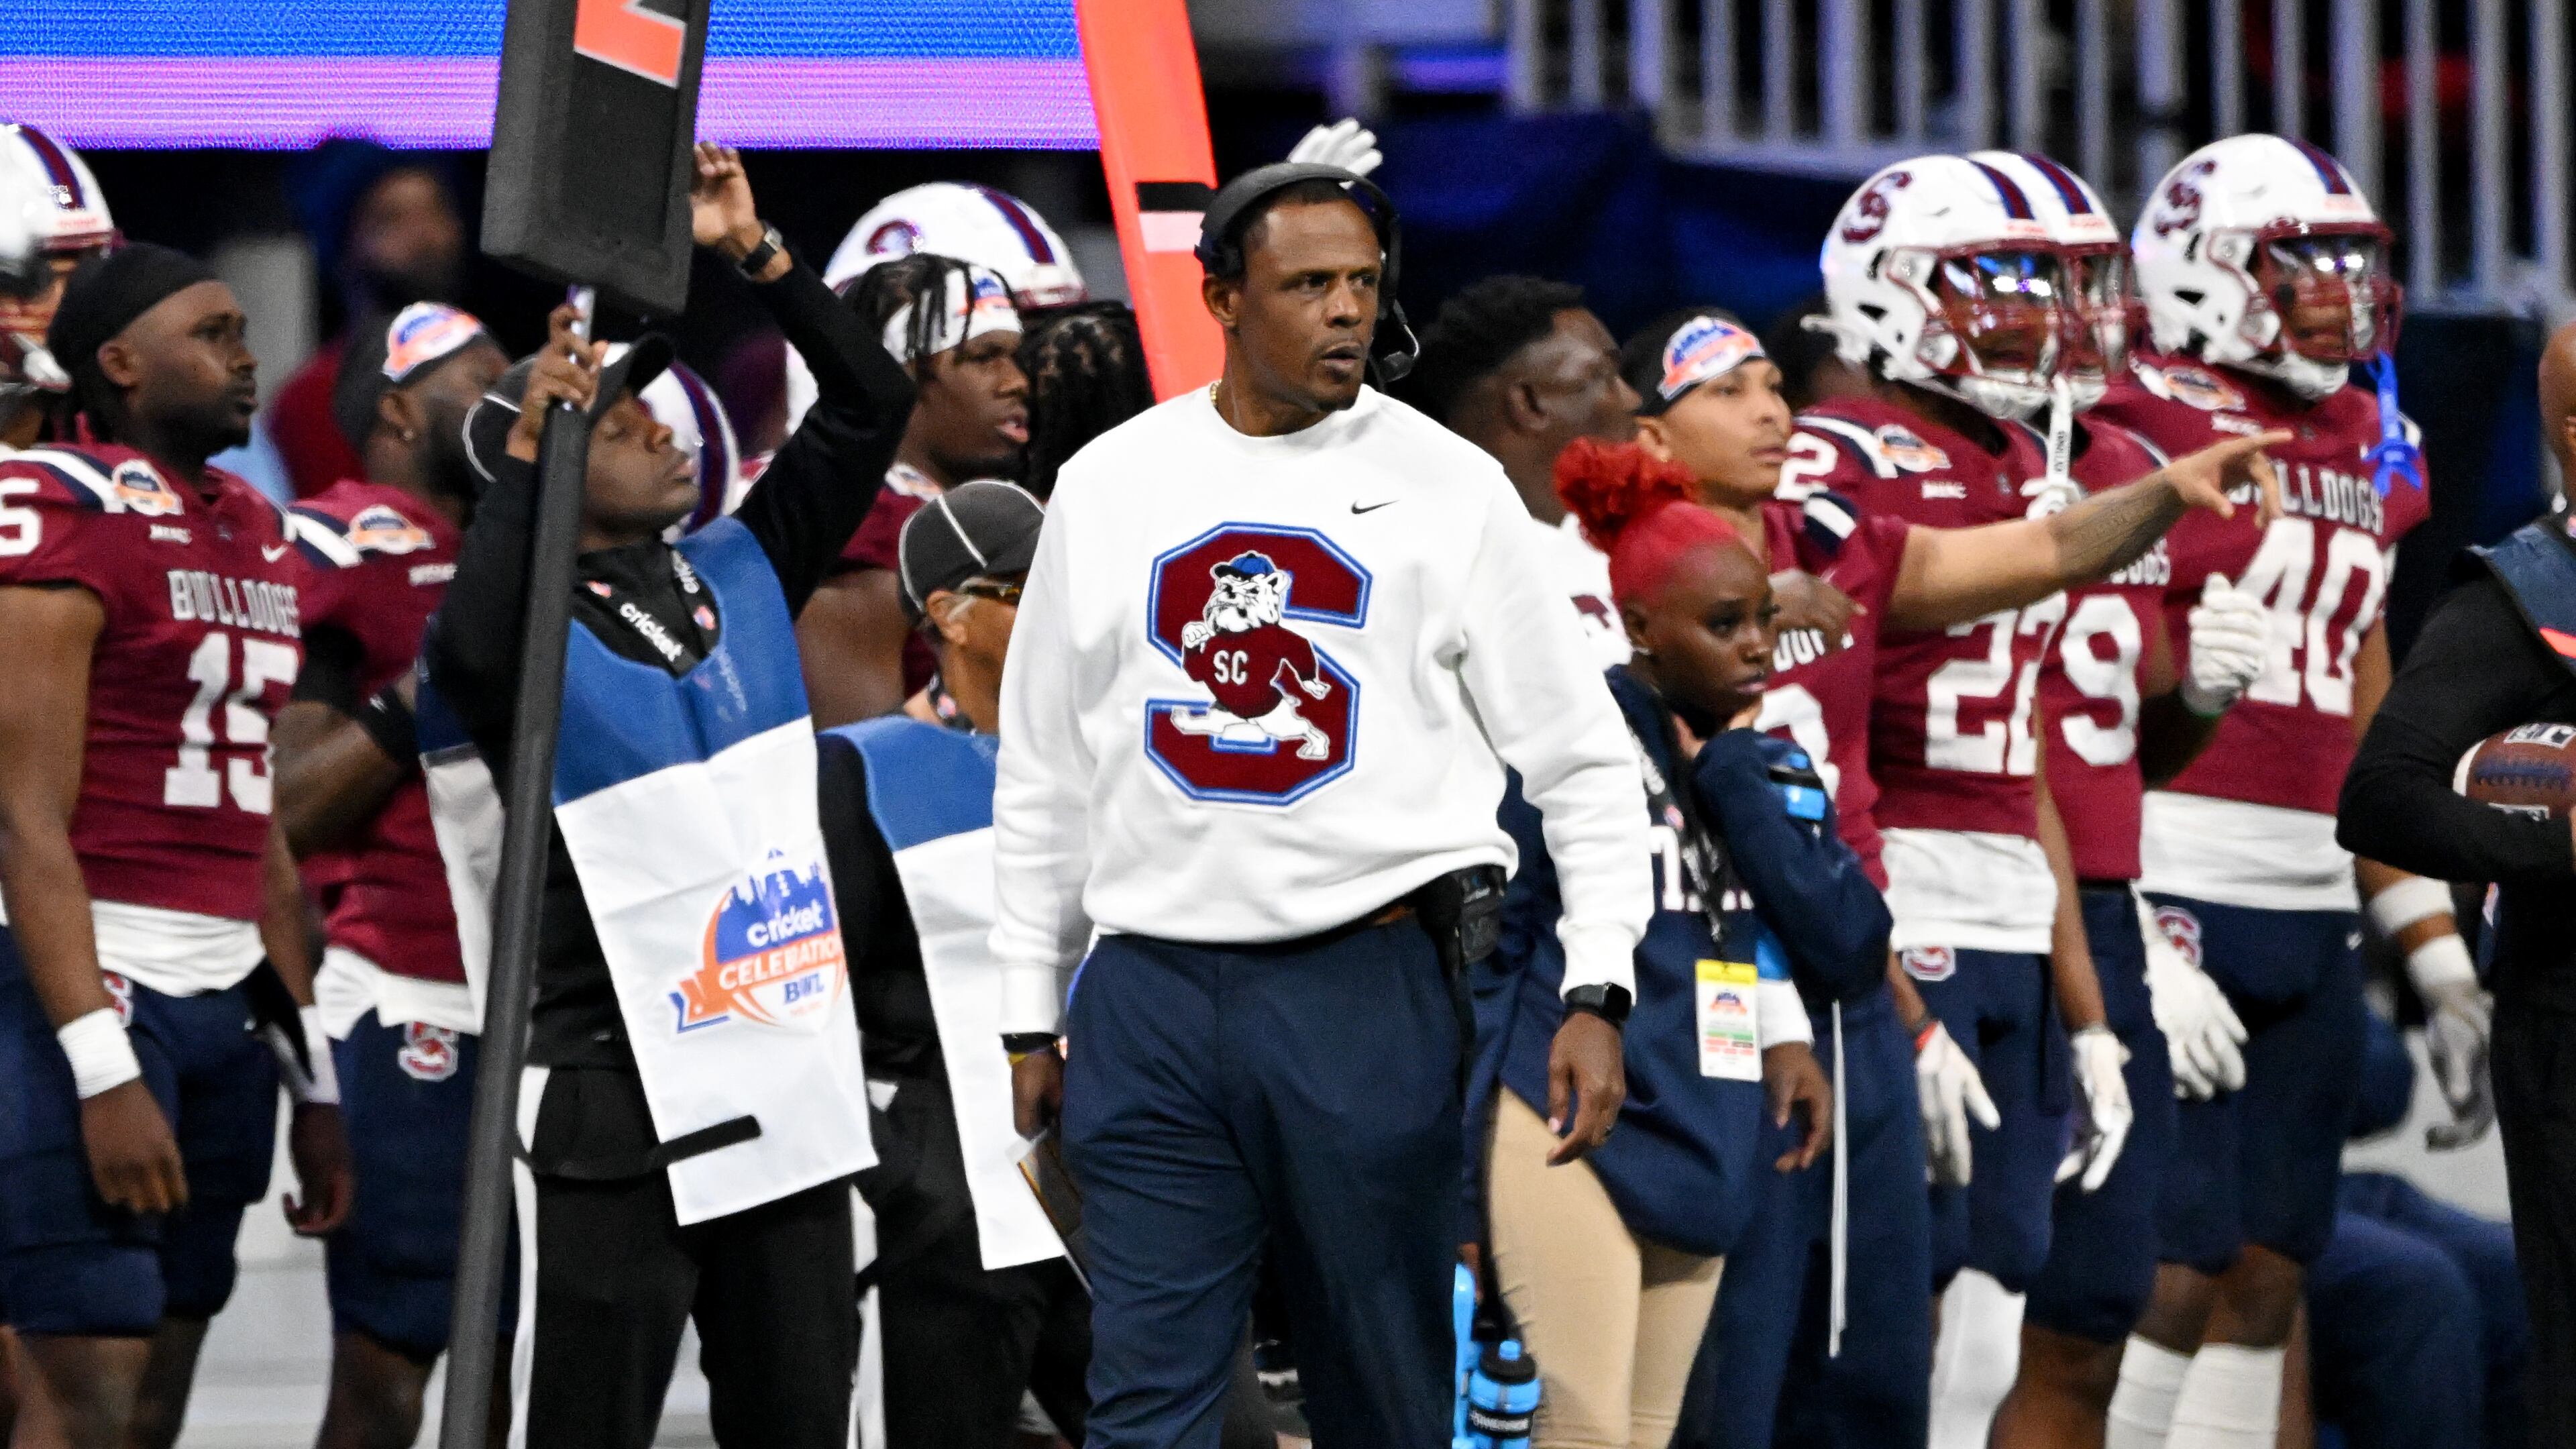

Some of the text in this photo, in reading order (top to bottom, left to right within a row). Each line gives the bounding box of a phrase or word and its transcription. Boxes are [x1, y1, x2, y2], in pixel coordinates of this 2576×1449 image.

[2226, 457, 2385, 536] LLDOGS
[167, 569, 302, 639] BULLDOGS
[620, 602, 684, 663] cricket
[2233, 514, 2385, 718] 40
[1213, 649, 1249, 685] SC
[164, 631, 300, 816] 15
[746, 898, 824, 948] cricket
